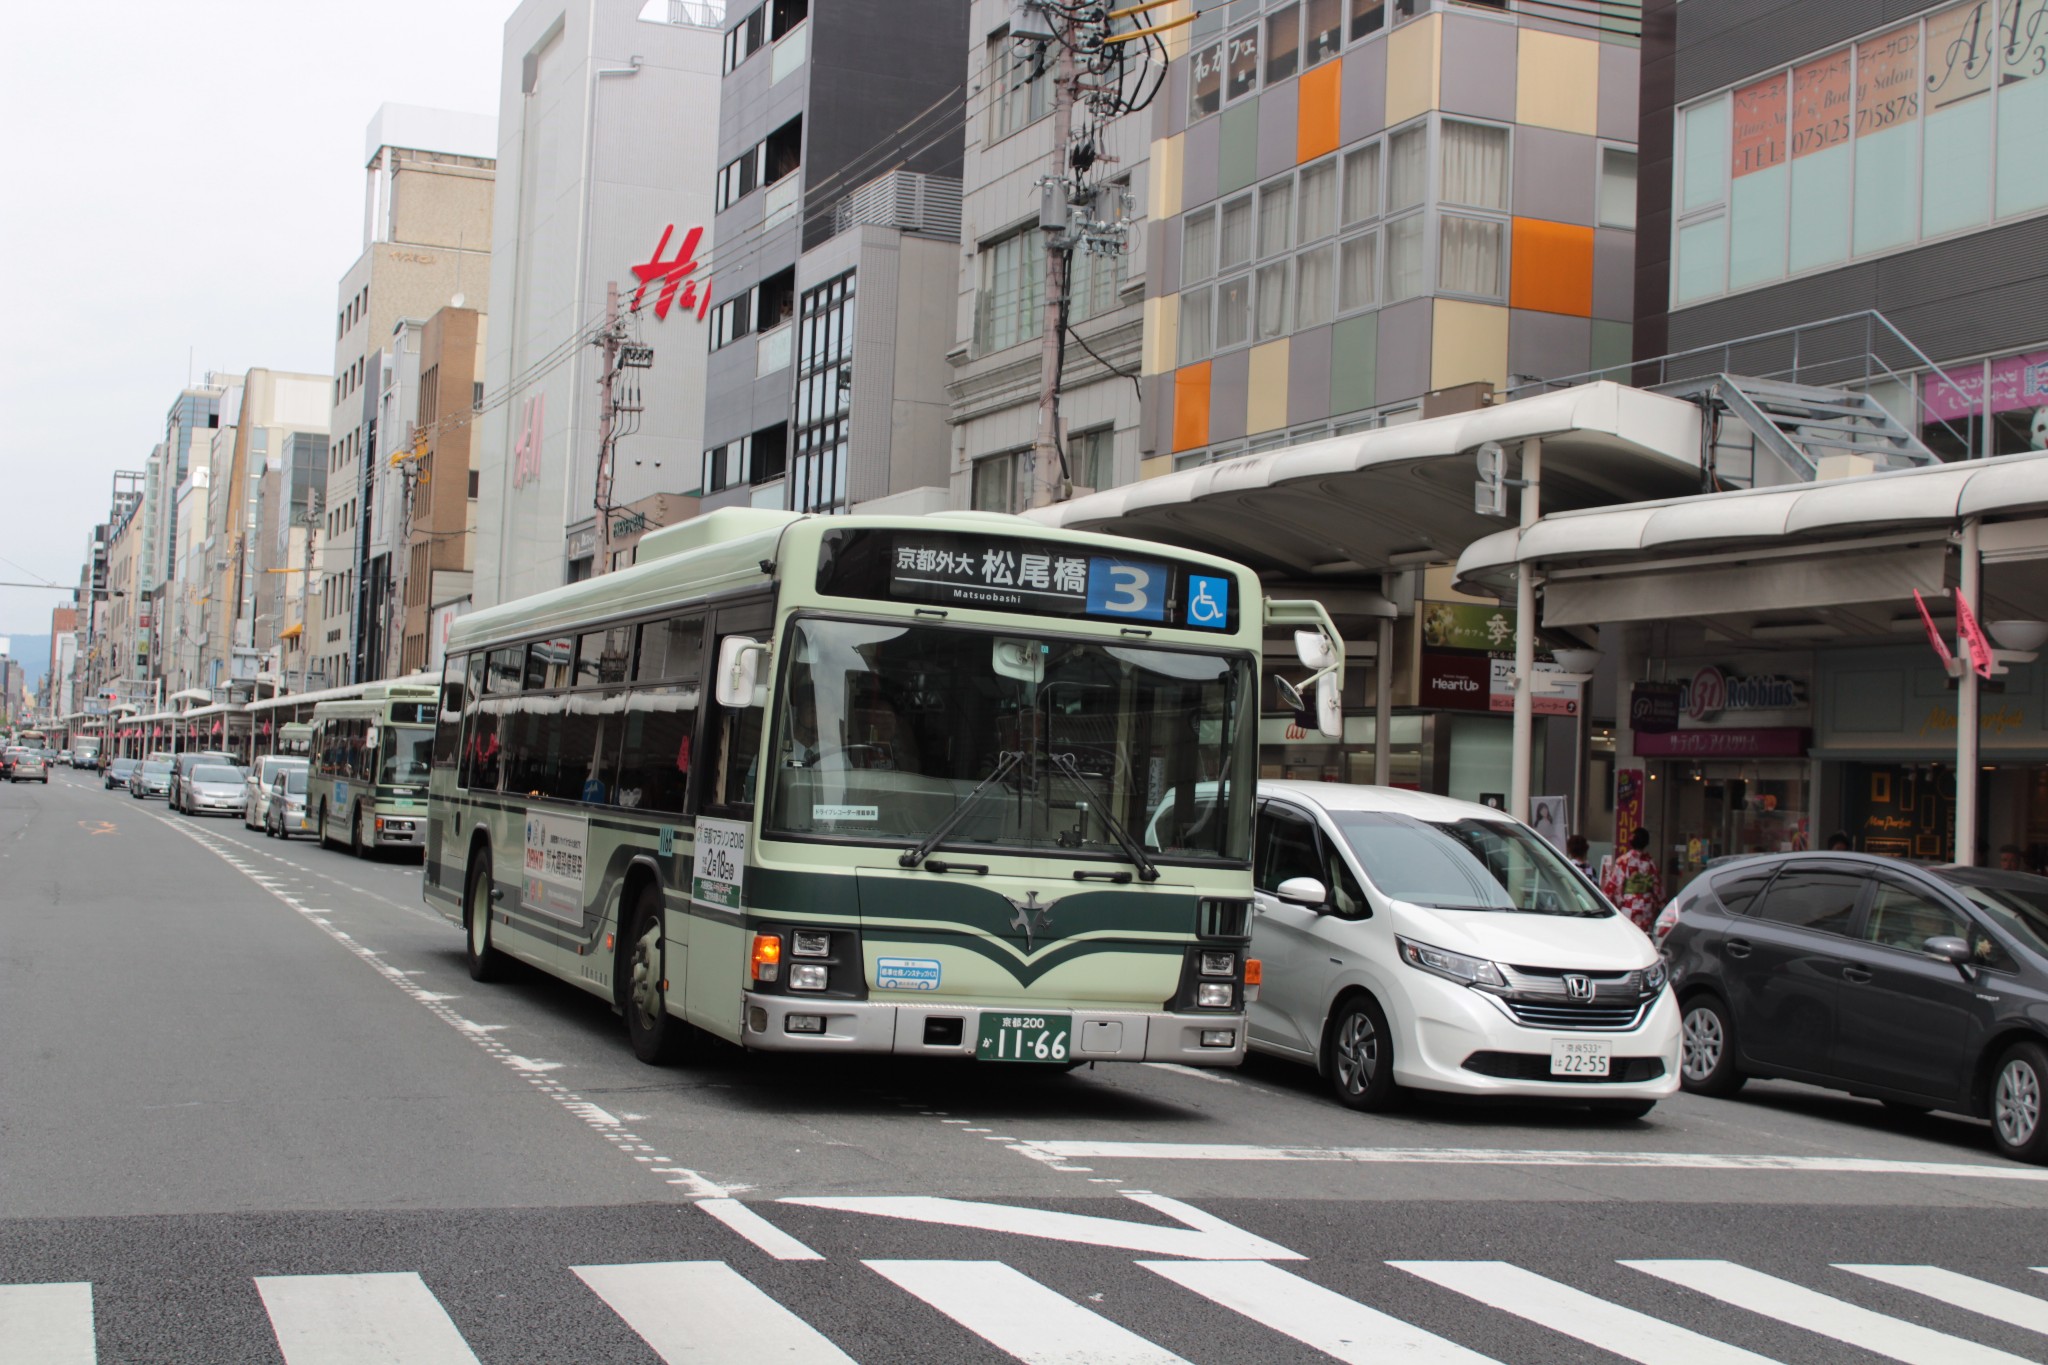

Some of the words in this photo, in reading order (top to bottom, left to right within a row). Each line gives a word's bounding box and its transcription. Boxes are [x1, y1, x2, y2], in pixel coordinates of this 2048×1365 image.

[1193, 39, 1256, 83] 和カフェ
[1873, 67, 1914, 90] Salon
[630, 223, 712, 321] H&
[896, 546, 975, 576] 京都外大
[981, 548, 1087, 594] 松尾橋
[953, 588, 1022, 604] Matsuobashi
[1104, 566, 1151, 613] 3
[1727, 677, 1794, 708] Robbins
[1284, 722, 1309, 740] au
[1670, 734, 1706, 751] サーティワン
[1710, 735, 1760, 751] アイスクリーム
[660, 827, 674, 853] 1166
[1002, 1016, 1045, 1029] 京都200
[982, 1037, 993, 1048] か
[998, 1028, 1067, 1060] 11-66
[1564, 1055, 1606, 1072] 22-55
